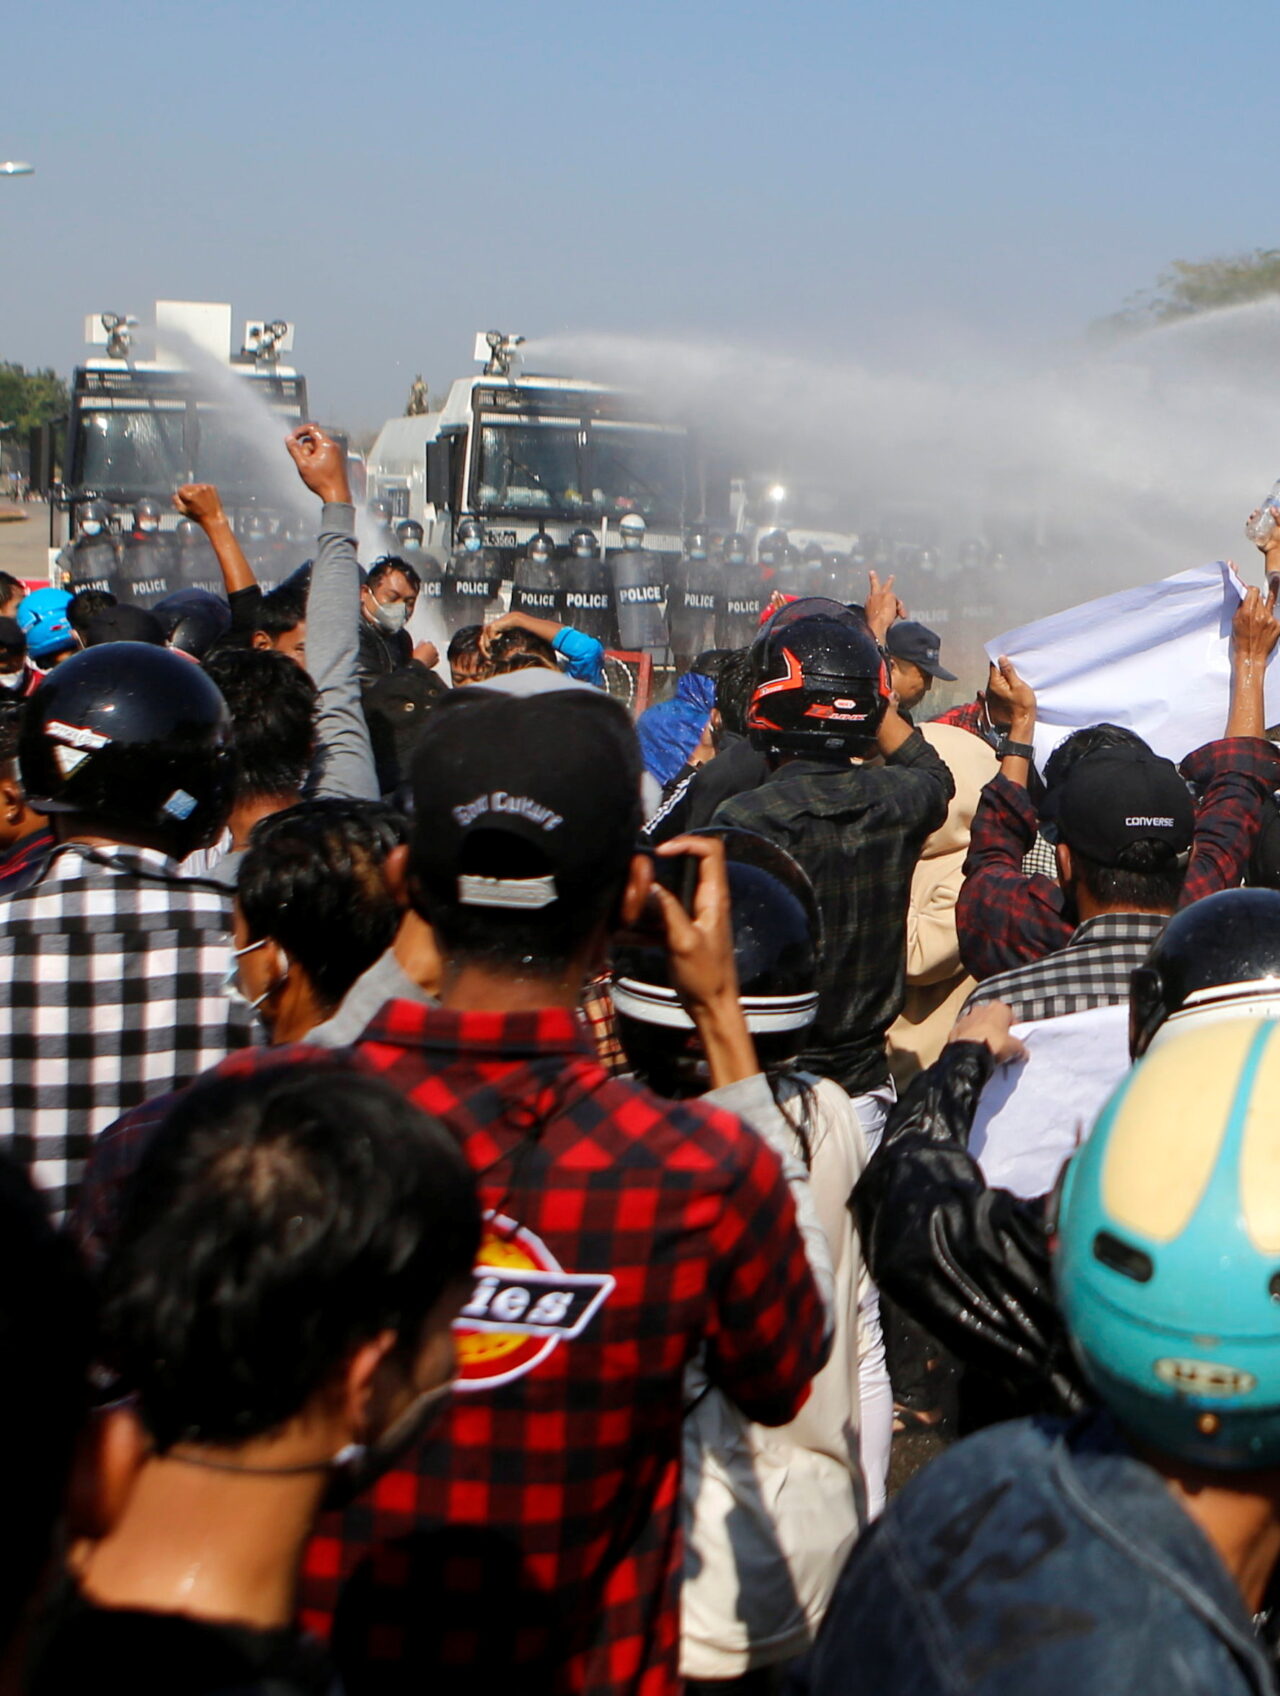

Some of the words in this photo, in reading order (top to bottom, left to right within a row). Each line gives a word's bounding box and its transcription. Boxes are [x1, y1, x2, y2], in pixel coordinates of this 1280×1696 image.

[132, 579, 167, 595] POLICE
[456, 581, 489, 595] POLICE
[619, 586, 661, 602] POLICE
[521, 592, 555, 607] POLICE
[566, 593, 608, 608] POLICE
[684, 593, 714, 608] POLICE
[728, 600, 759, 613] POLICE
[1125, 816, 1175, 827] CONVERSE
[460, 1277, 575, 1325] ies
